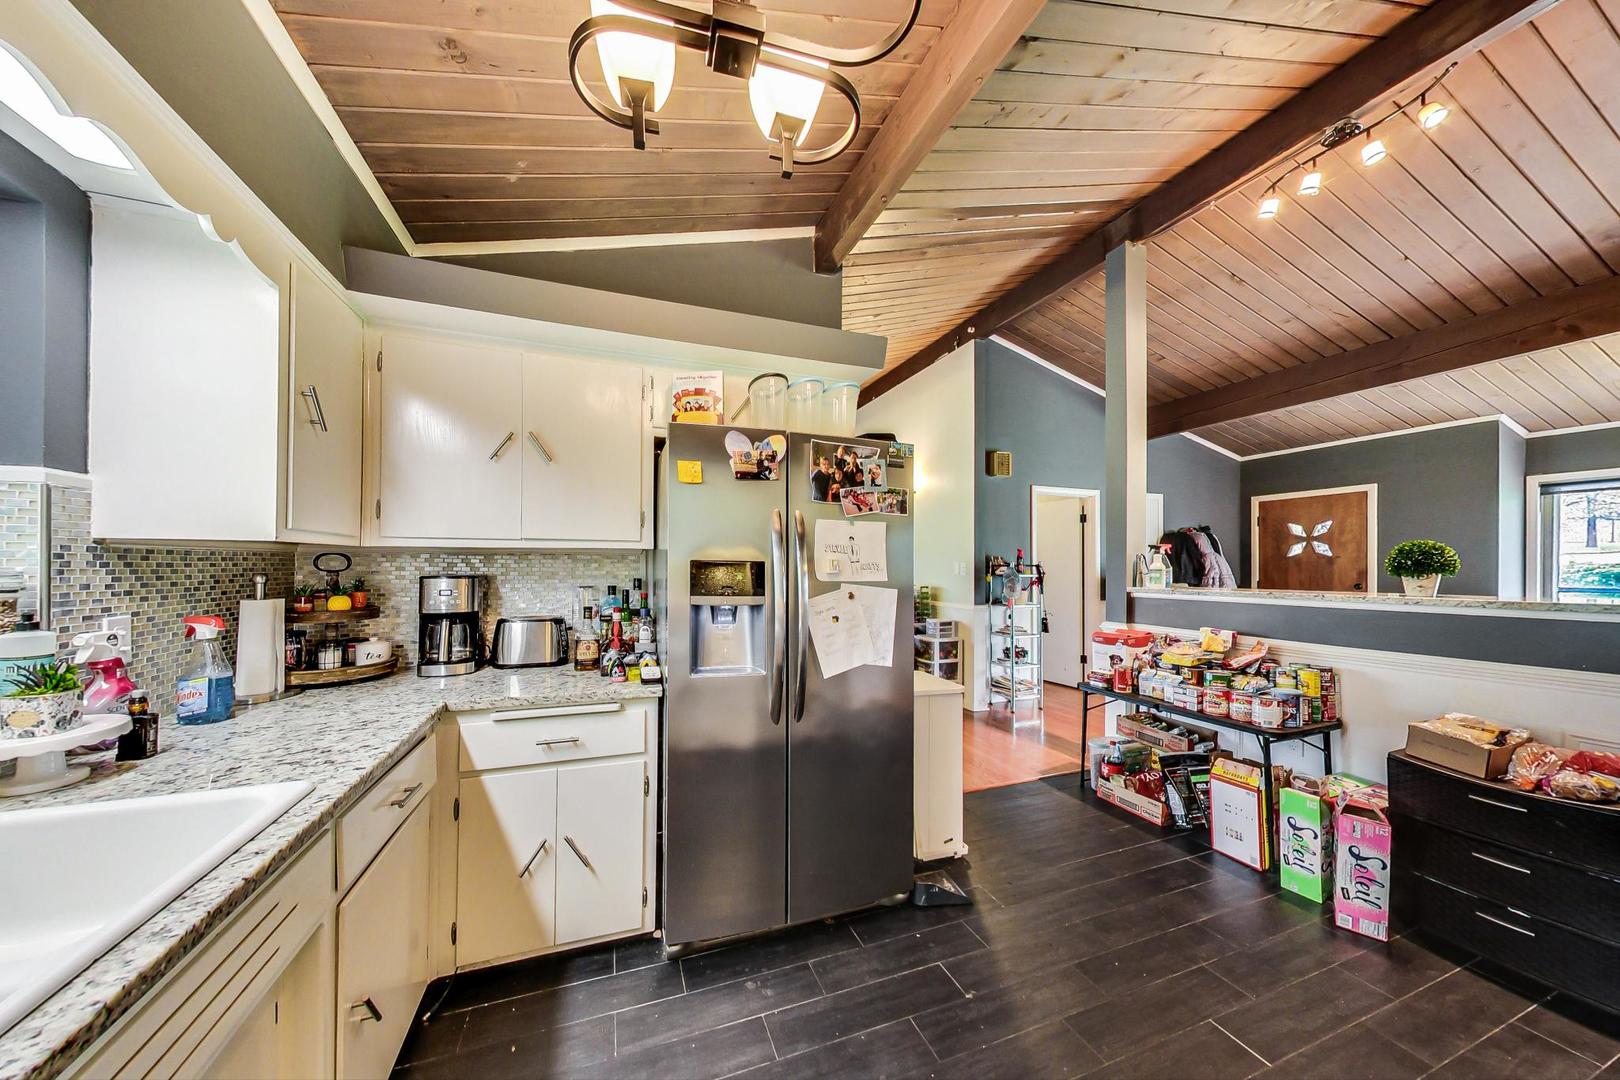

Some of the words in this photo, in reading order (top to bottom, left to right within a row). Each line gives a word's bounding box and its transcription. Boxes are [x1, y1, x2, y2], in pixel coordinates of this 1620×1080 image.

[364, 651, 384, 660] tea
[1287, 816, 1319, 875] Soleil
[1348, 845, 1388, 910] Soleil
